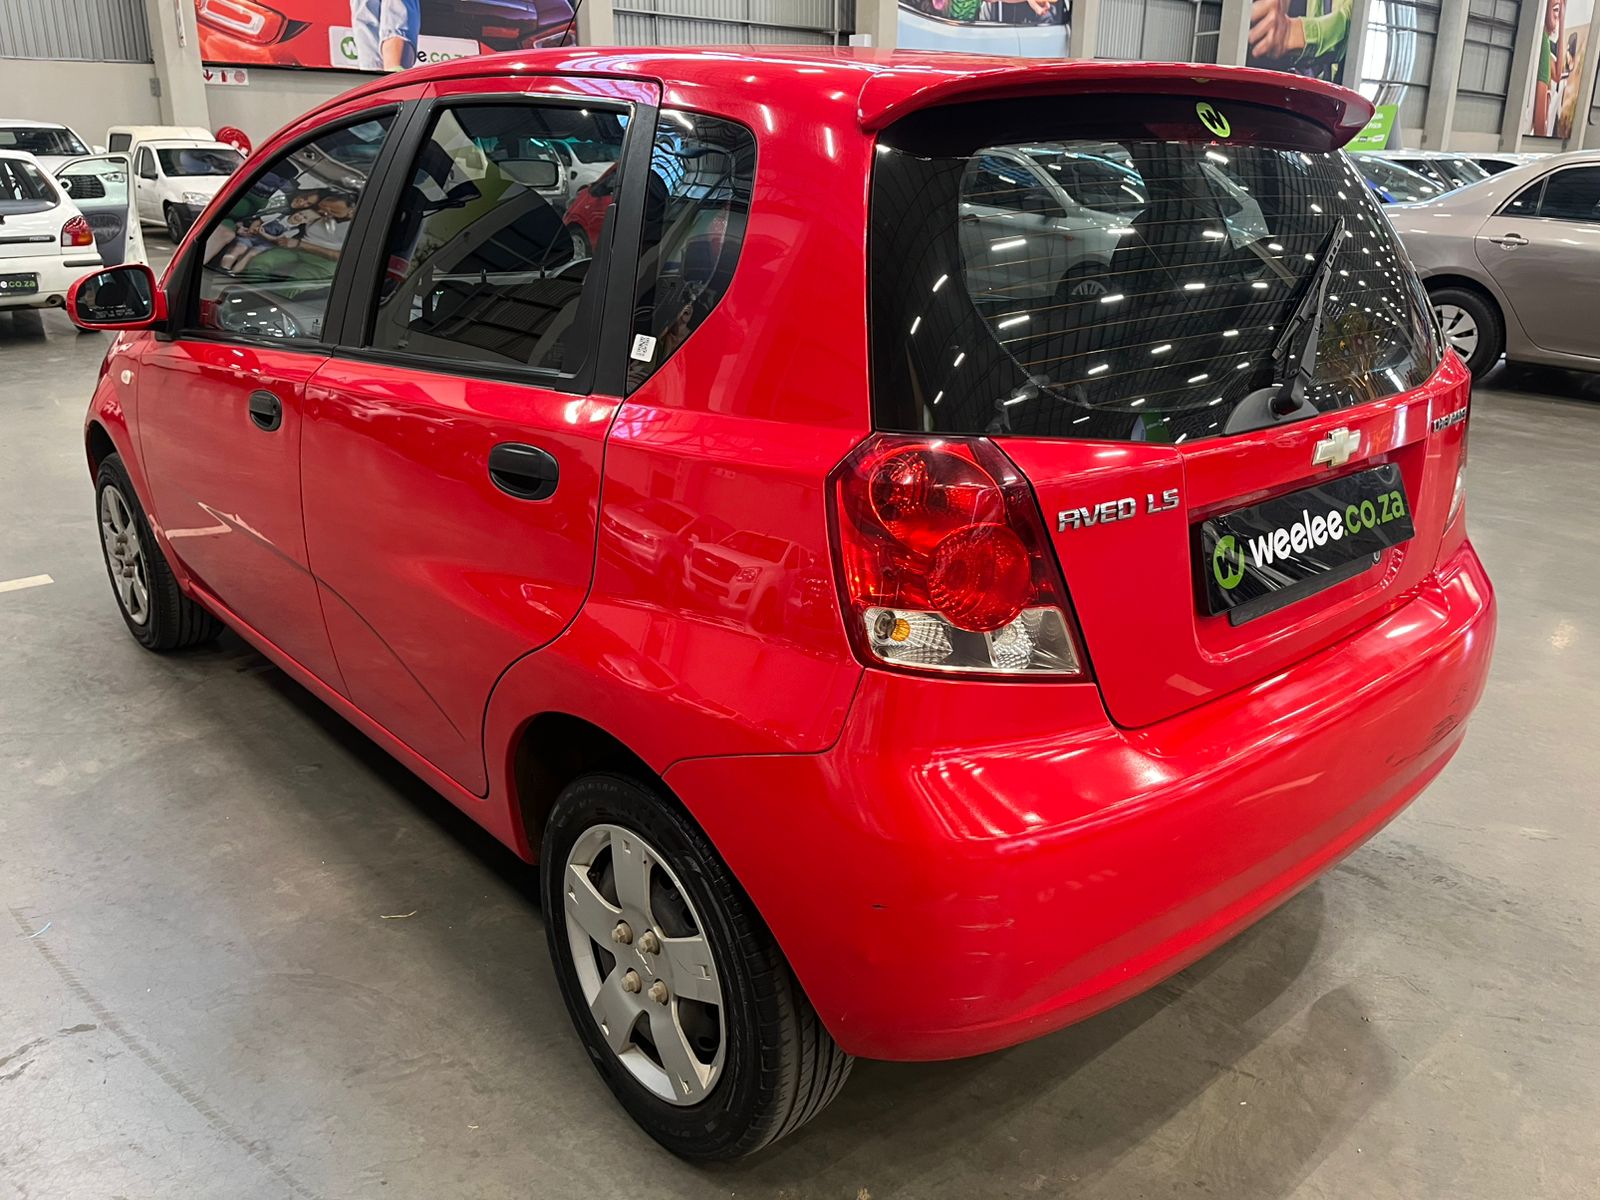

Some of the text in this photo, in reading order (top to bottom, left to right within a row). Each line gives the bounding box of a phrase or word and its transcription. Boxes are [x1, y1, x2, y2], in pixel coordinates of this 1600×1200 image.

[417, 51, 463, 62] e.co
[1058, 488, 1179, 532] AVEO LS
[1248, 490, 1406, 568] weelee.co.za
